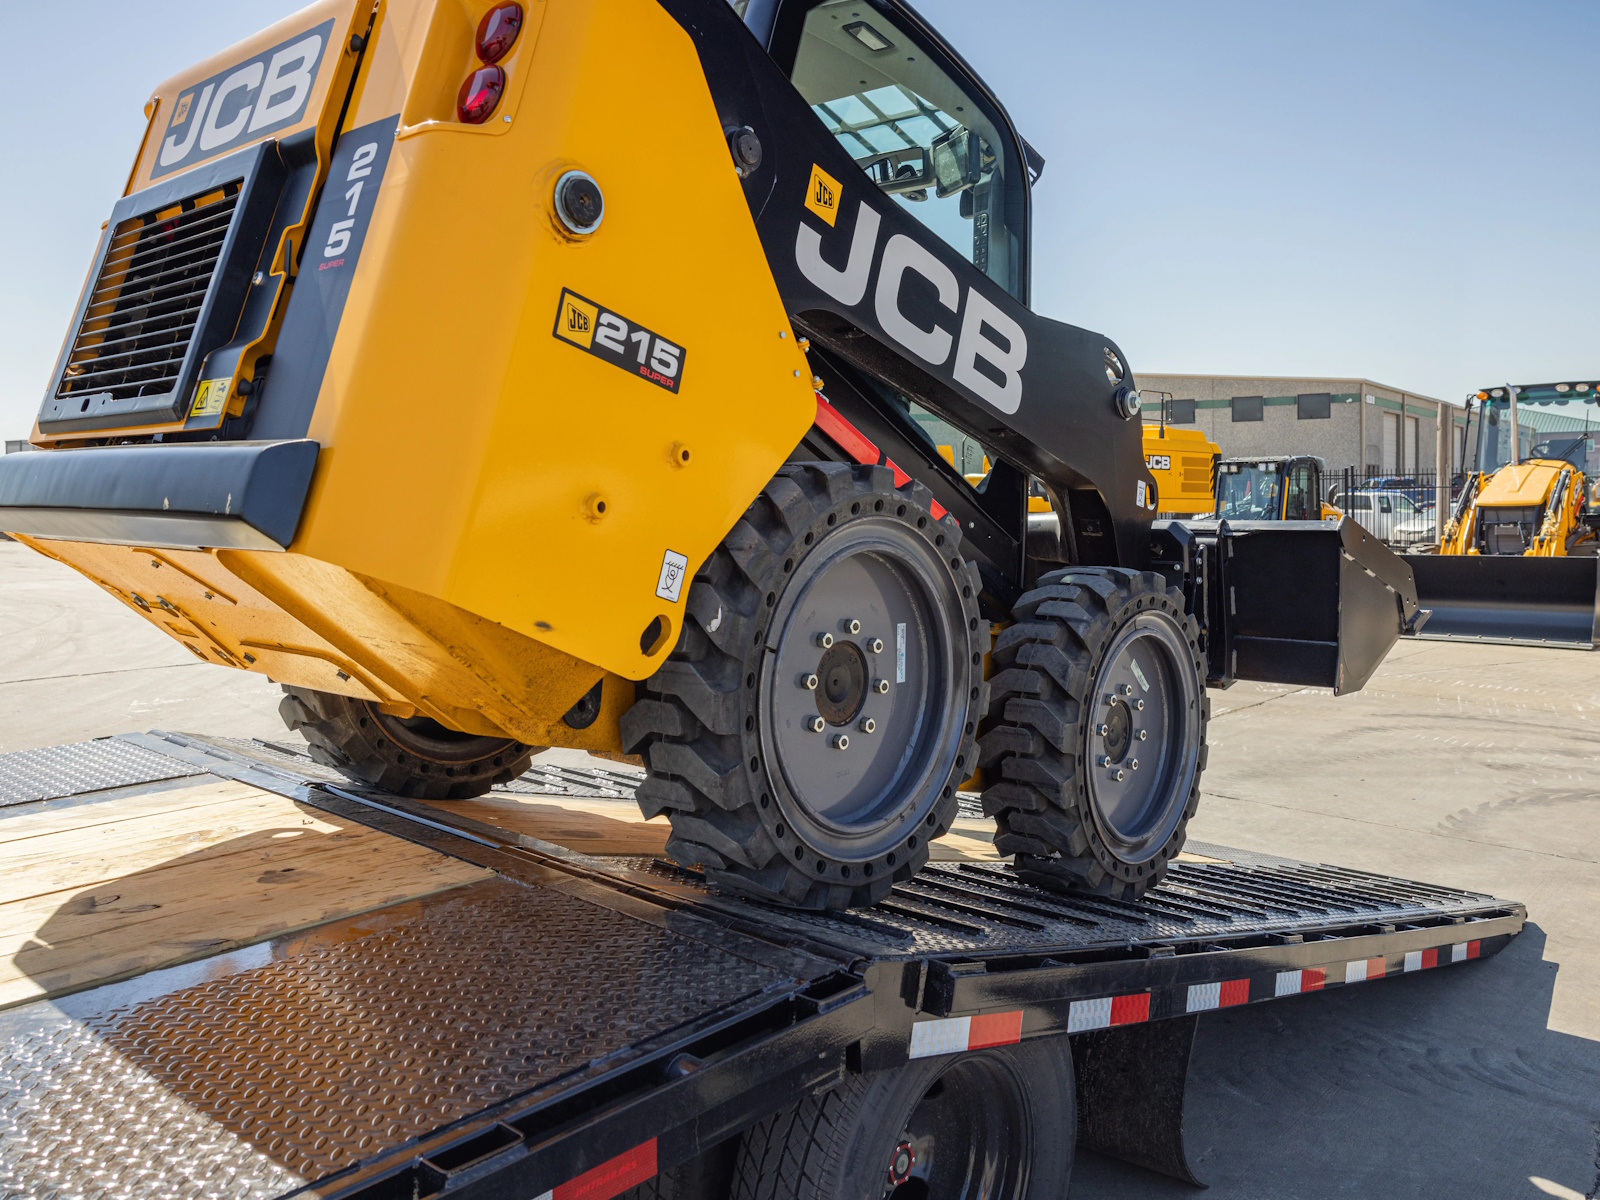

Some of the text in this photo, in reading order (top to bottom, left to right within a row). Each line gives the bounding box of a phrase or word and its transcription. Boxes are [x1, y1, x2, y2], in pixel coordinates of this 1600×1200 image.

[160, 34, 322, 167] JCB
[324, 142, 378, 258] 215
[816, 180, 834, 207] JCB
[318, 259, 345, 271] SUPER
[795, 200, 1028, 415] JCB
[569, 307, 681, 378] JCB 215
[640, 365, 675, 388] SUPER
[1145, 455, 1171, 470] JCB
